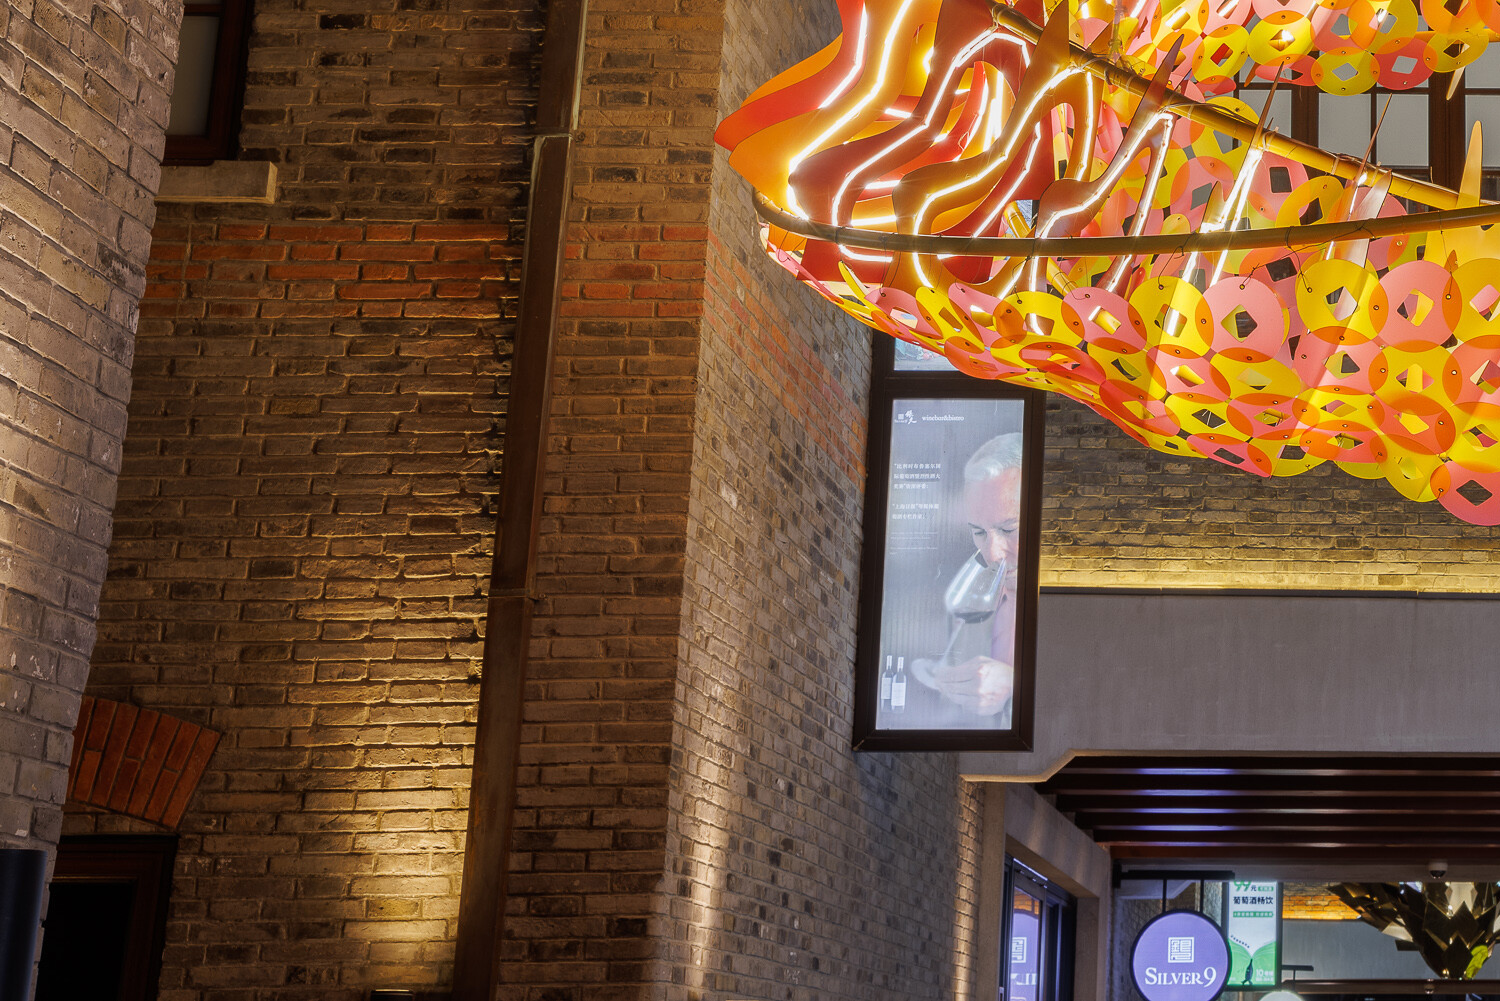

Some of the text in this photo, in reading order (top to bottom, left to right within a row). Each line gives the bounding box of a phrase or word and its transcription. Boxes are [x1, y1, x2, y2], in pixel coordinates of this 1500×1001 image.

[1233, 896, 1273, 904] 葡萄酒畅饮
